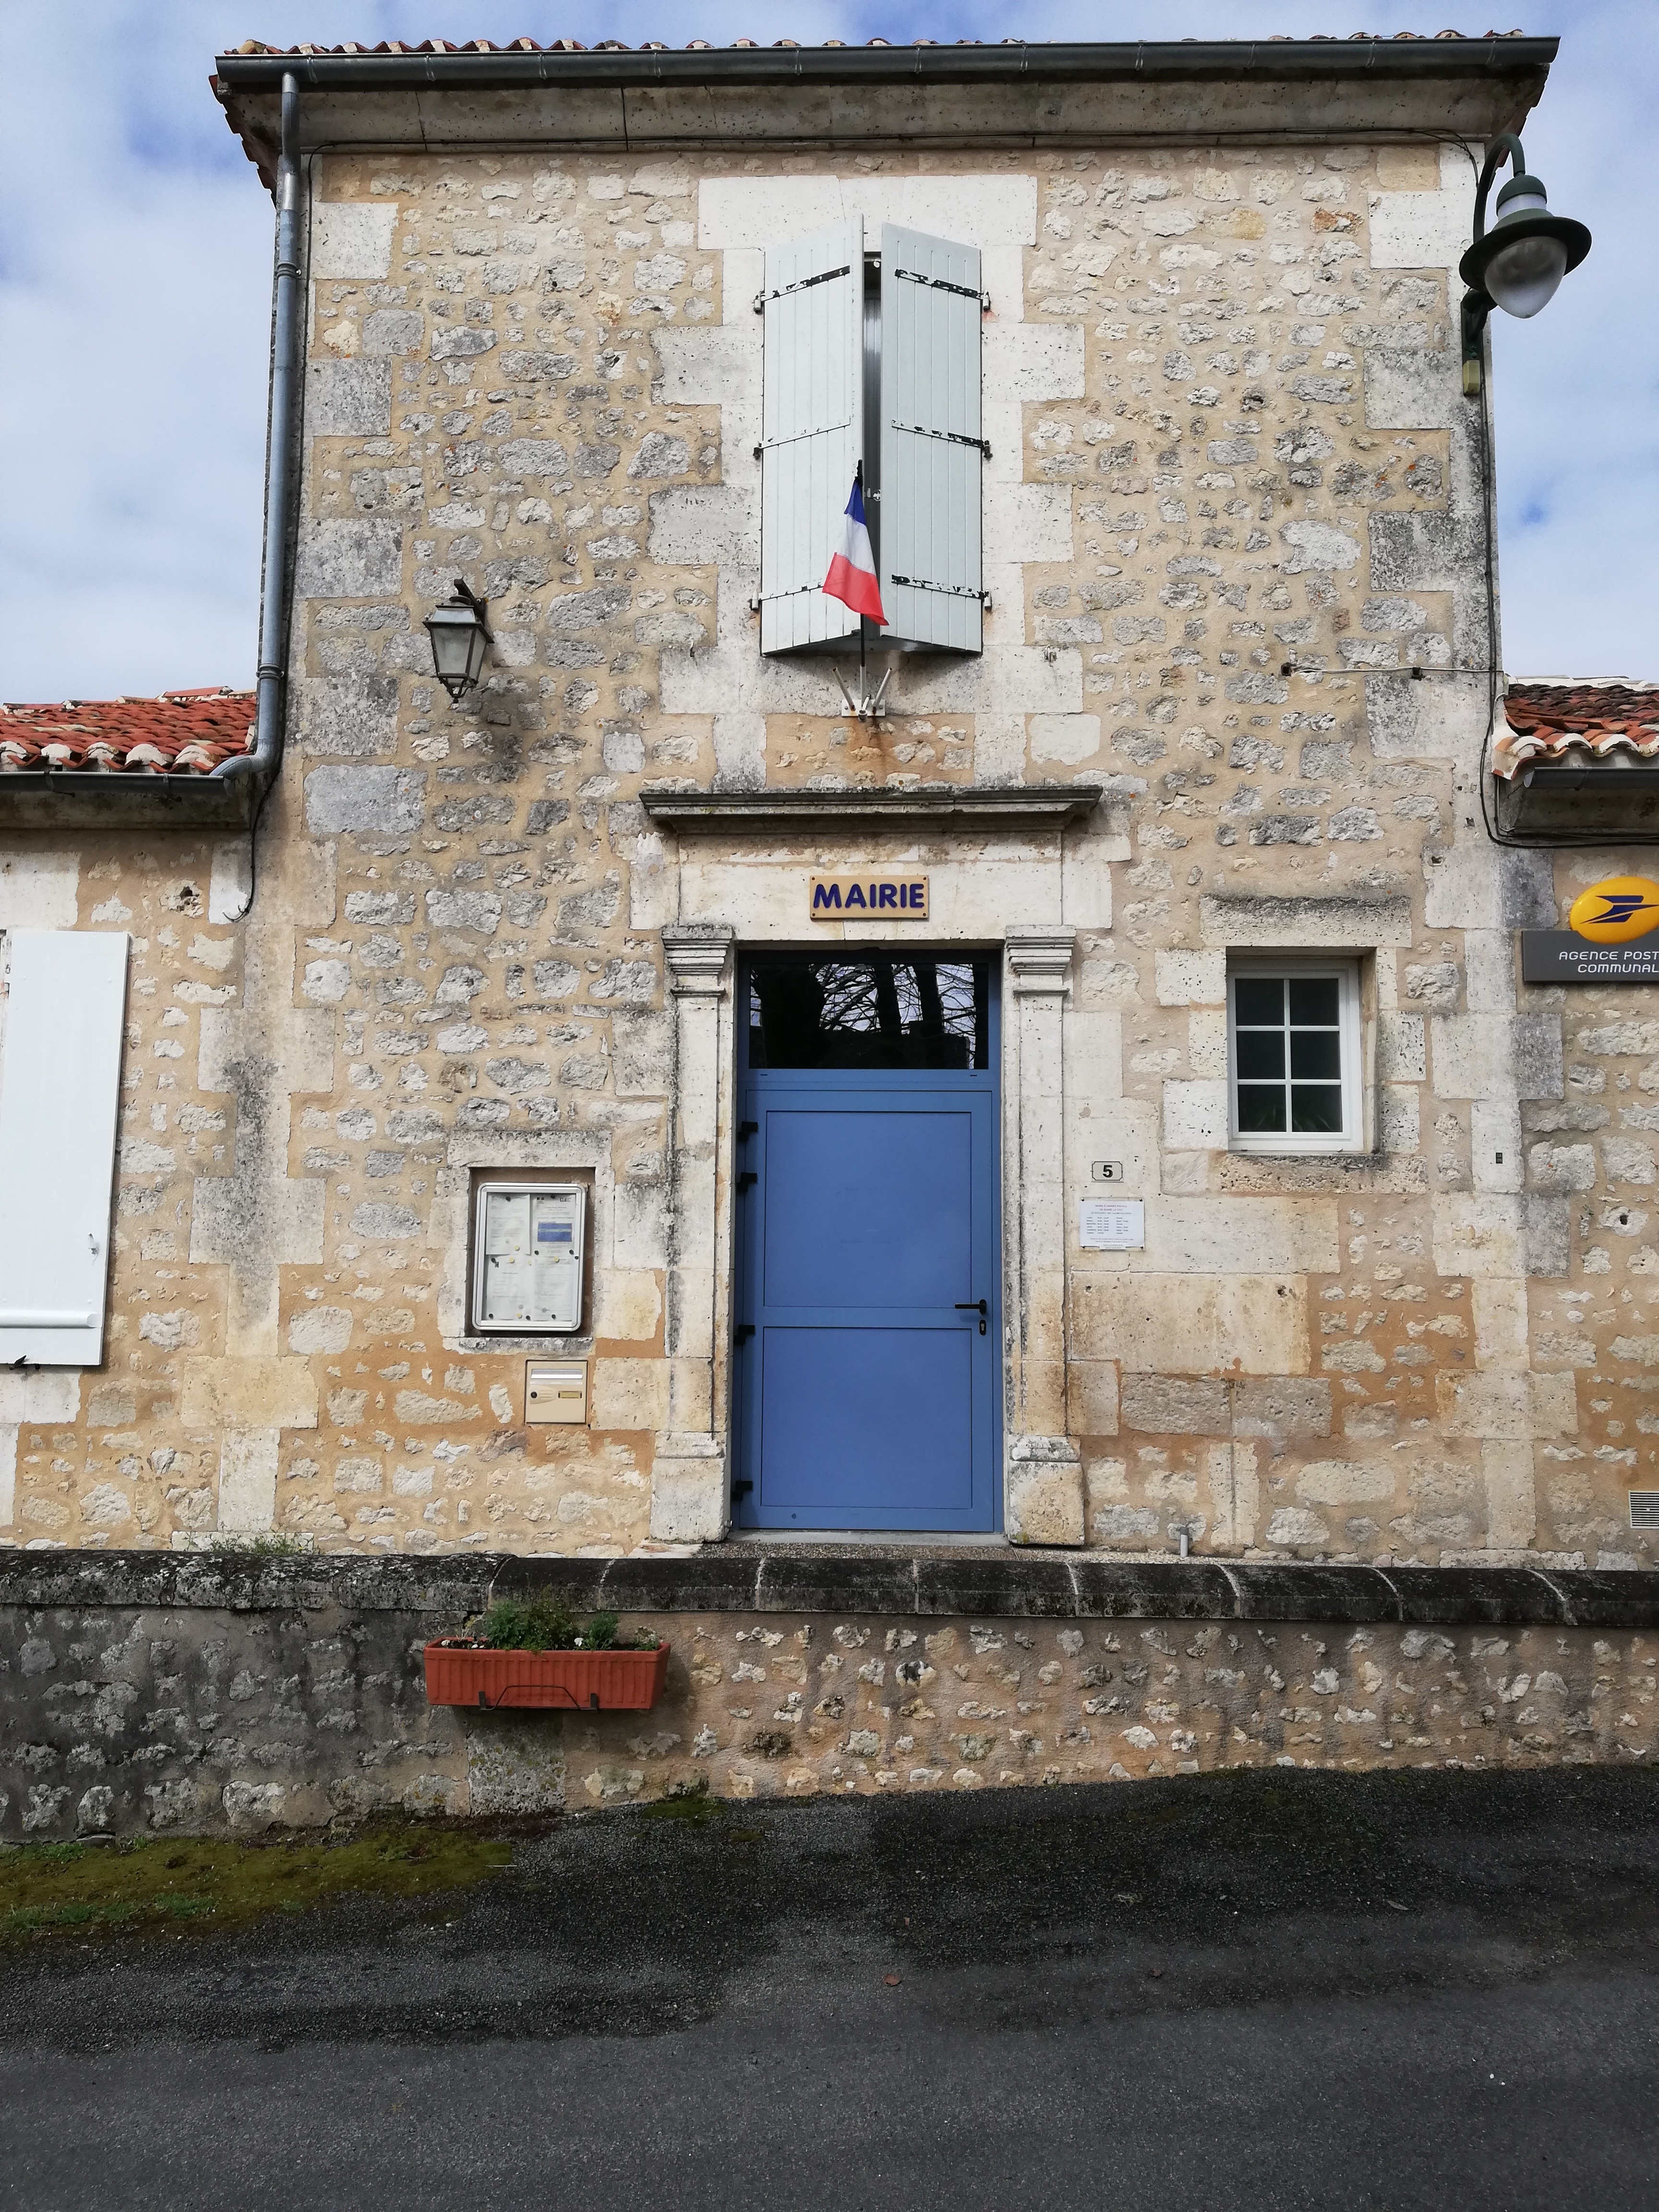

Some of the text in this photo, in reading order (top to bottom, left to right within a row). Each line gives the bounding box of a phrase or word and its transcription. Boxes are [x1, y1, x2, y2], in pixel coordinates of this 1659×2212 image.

[813, 884, 925, 908] MAIRIE
[1559, 951, 1659, 960] AGENCE POST
[1577, 964, 1659, 973] COMMUNAL
[1103, 1165, 1113, 1178] 5
